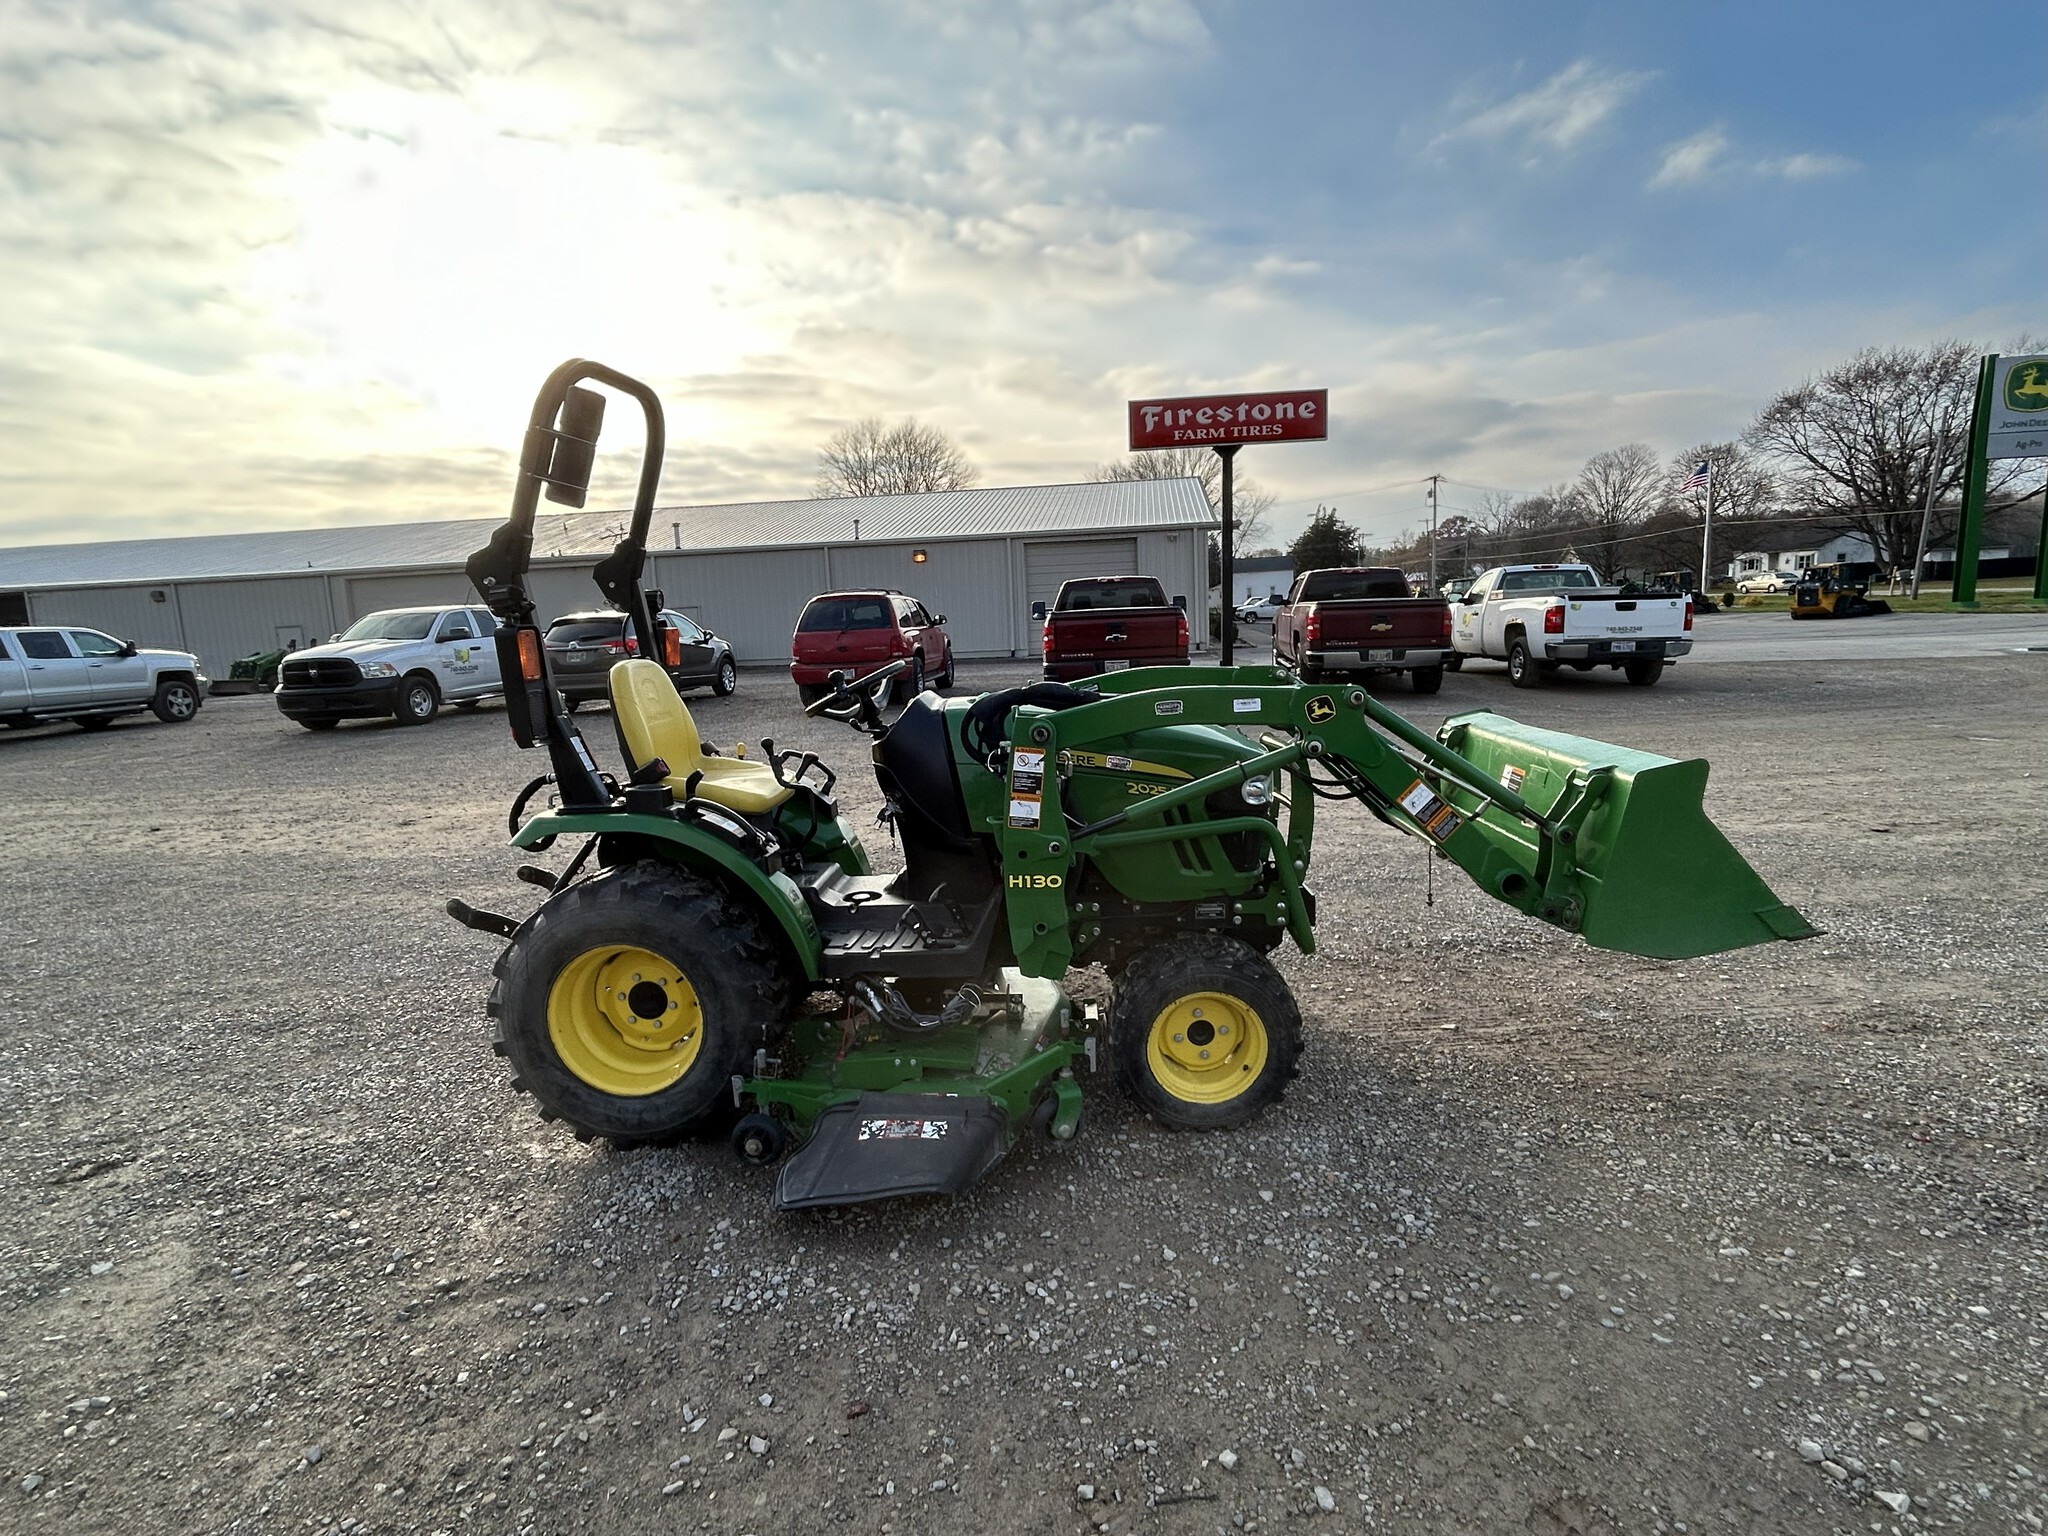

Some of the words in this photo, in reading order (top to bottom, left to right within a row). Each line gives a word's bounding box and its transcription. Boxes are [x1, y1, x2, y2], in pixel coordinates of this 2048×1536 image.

[1140, 400, 1317, 433] Firestone
[1173, 427, 1225, 441] FARM
[1230, 424, 1283, 437] TIRES
[2015, 439, 2043, 450] Ag-Pro
[1126, 782, 1174, 795] 2025
[1009, 875, 1062, 888] H130
